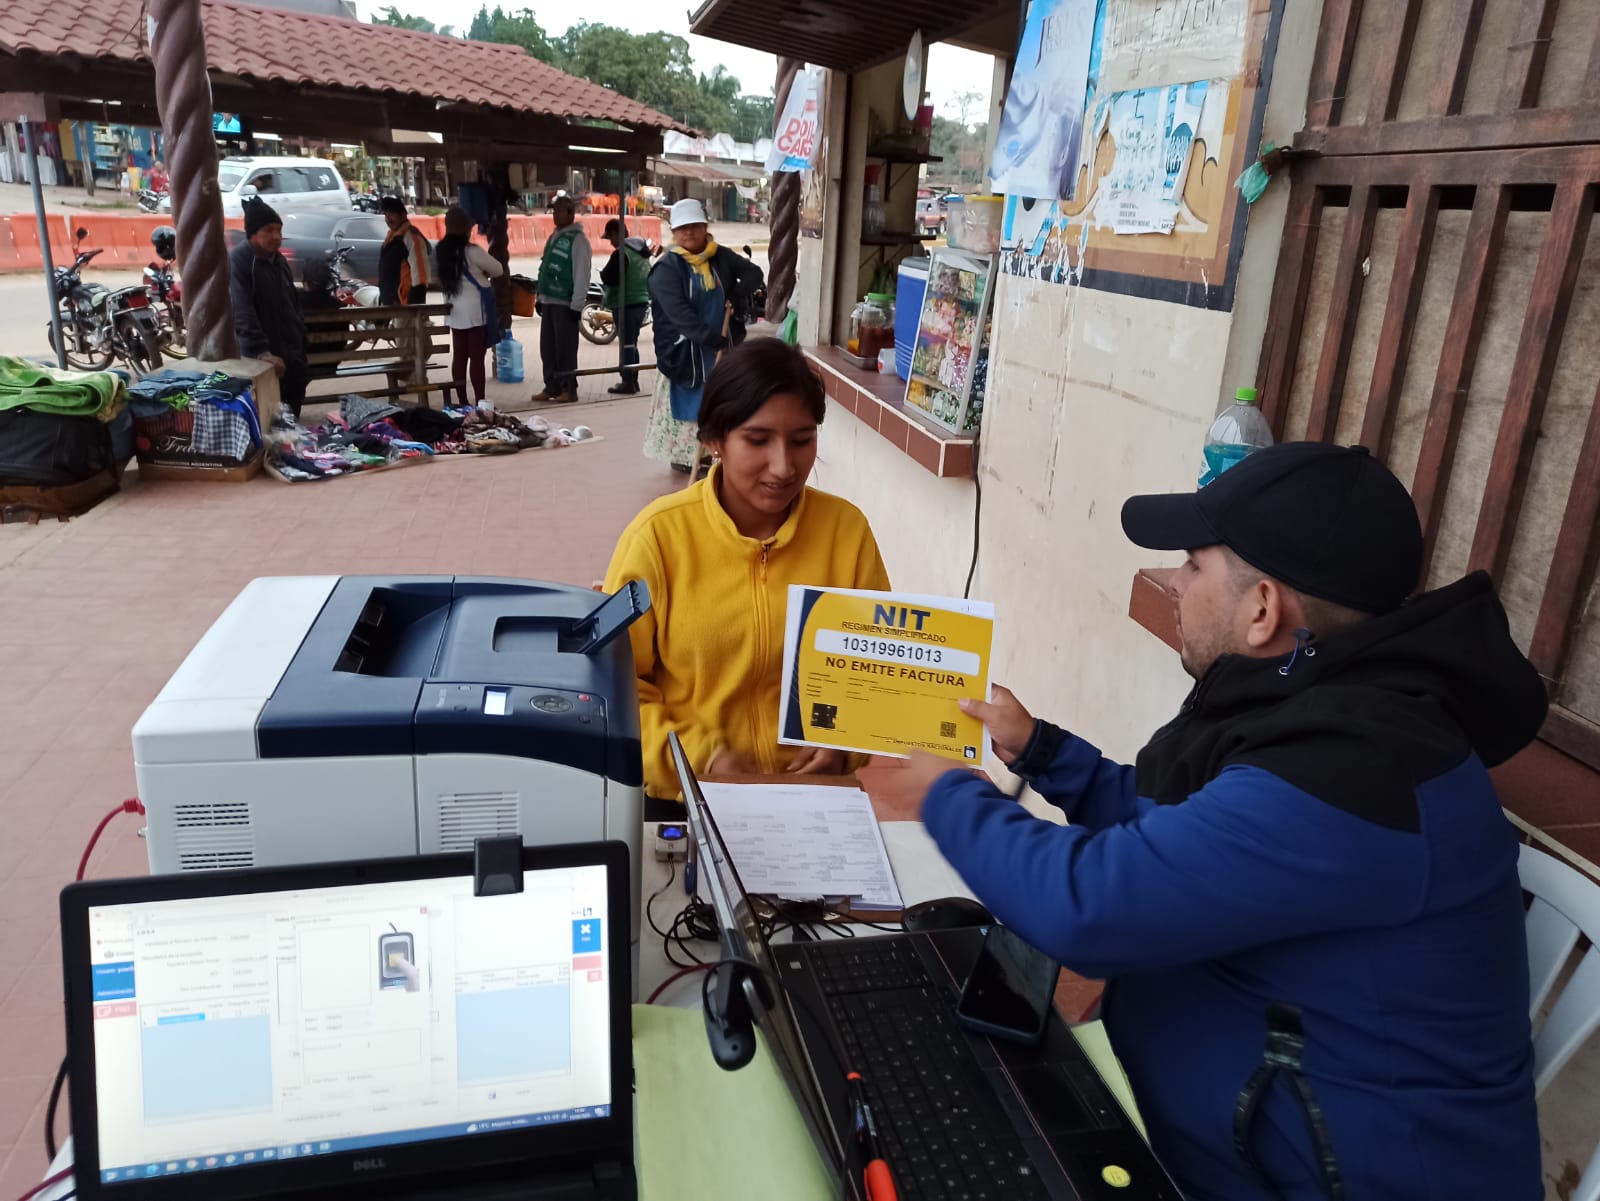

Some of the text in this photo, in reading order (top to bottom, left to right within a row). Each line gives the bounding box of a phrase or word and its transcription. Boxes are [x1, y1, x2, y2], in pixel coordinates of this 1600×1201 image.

[873, 603, 931, 631] NIT
[884, 627, 946, 643] SIMPLIFICADO
[842, 636, 943, 663] 10319961013
[825, 656, 965, 687] NO EMITE FACTURA
[353, 1158, 386, 1171] DELL
